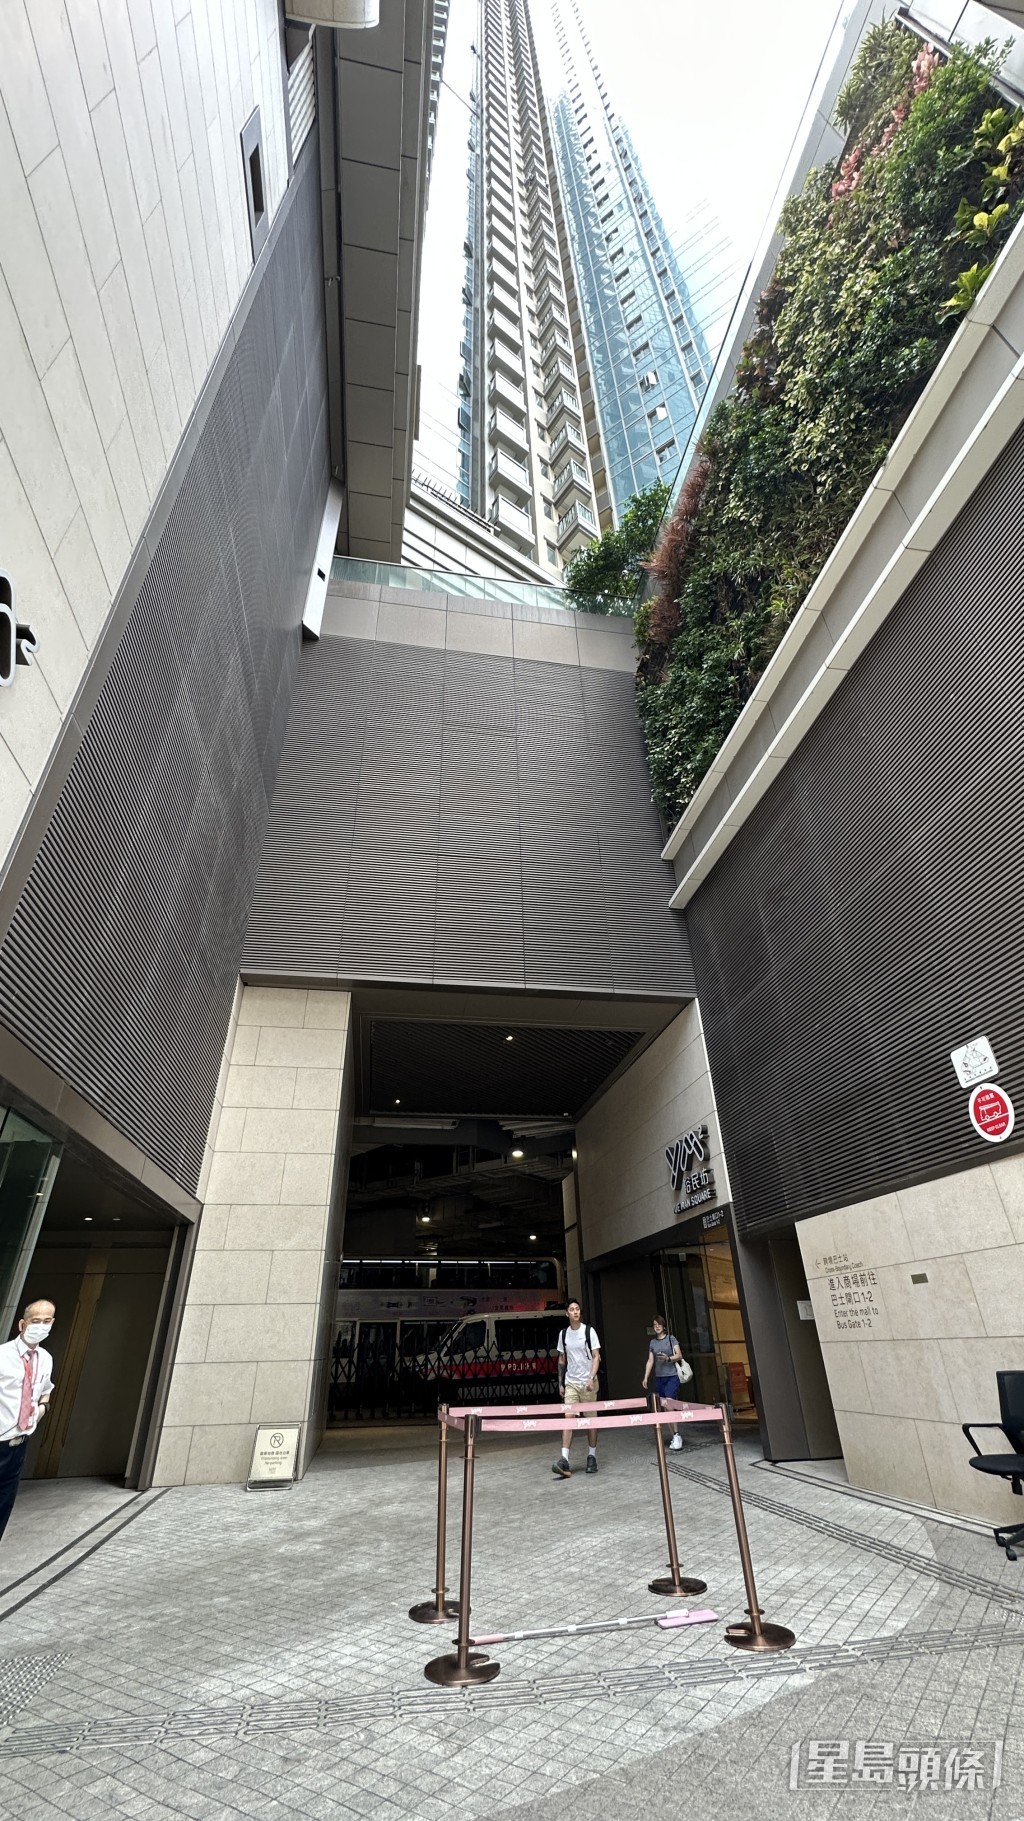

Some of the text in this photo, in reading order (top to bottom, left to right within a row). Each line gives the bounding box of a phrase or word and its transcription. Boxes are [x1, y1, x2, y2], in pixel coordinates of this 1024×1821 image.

[691, 1188, 712, 1206] SQUARE
[828, 1271, 878, 1291] 進入商場前往
[834, 1306, 879, 1318] Enter the mall to
[837, 1318, 873, 1329] Bus Gate 1-2
